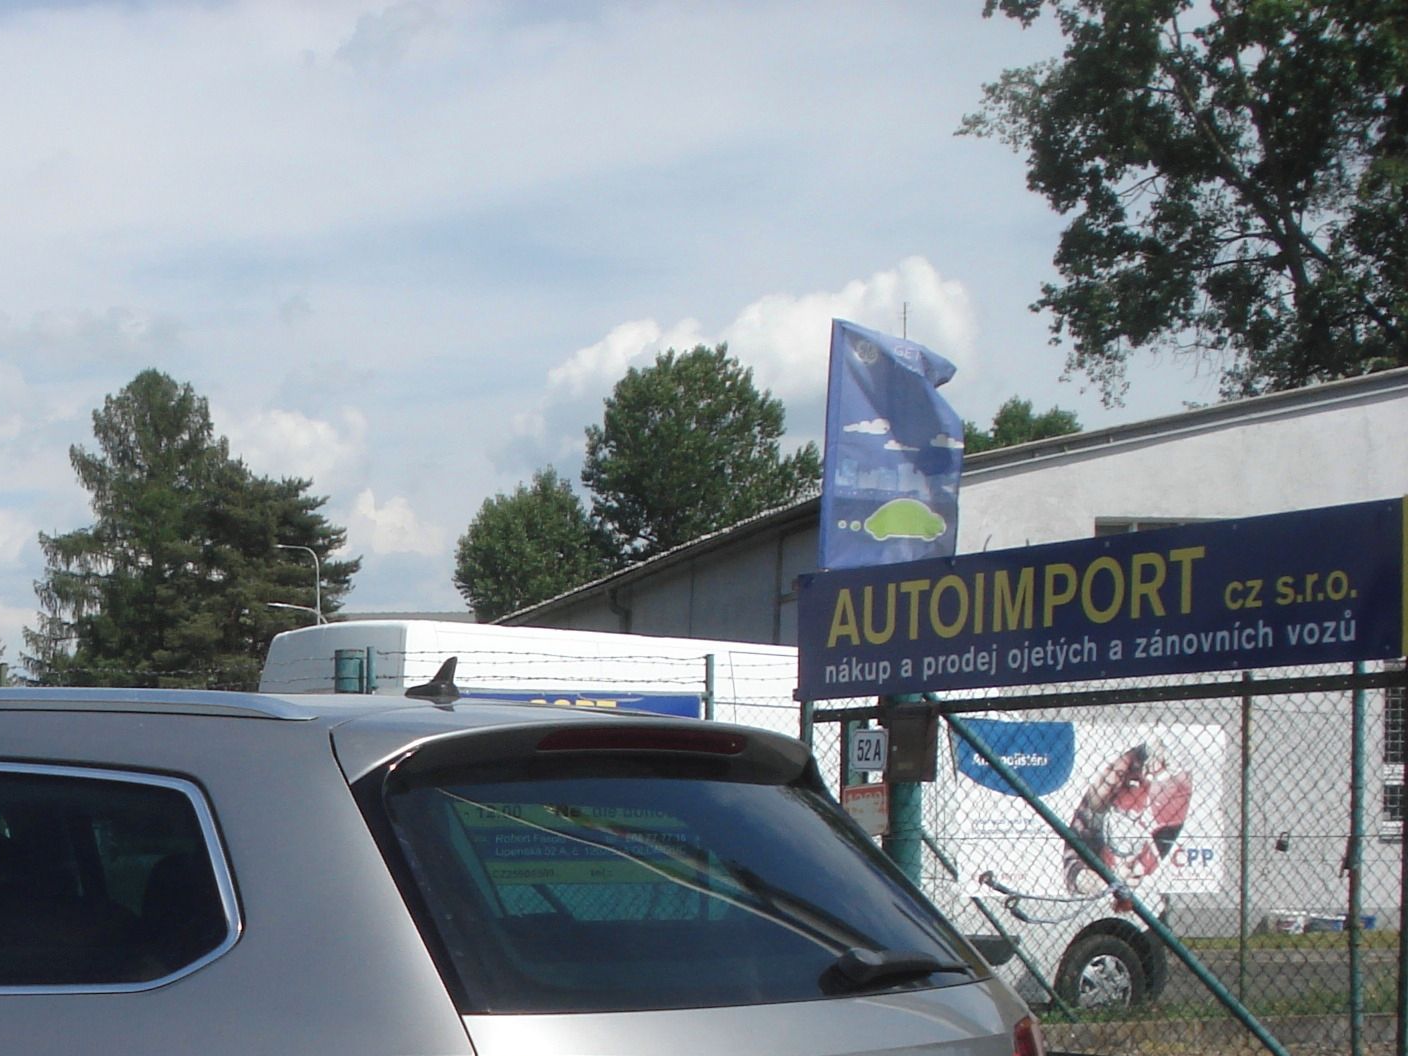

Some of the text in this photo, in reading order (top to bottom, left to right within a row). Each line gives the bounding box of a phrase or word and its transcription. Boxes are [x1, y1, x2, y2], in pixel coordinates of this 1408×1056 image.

[826, 545, 1206, 648] AUTOIMPORT
[1276, 569, 1358, 606] s.r.o.
[824, 609, 1357, 684] nákup a prodej ojetých a zánovních vozů
[856, 738, 882, 761] 52 A
